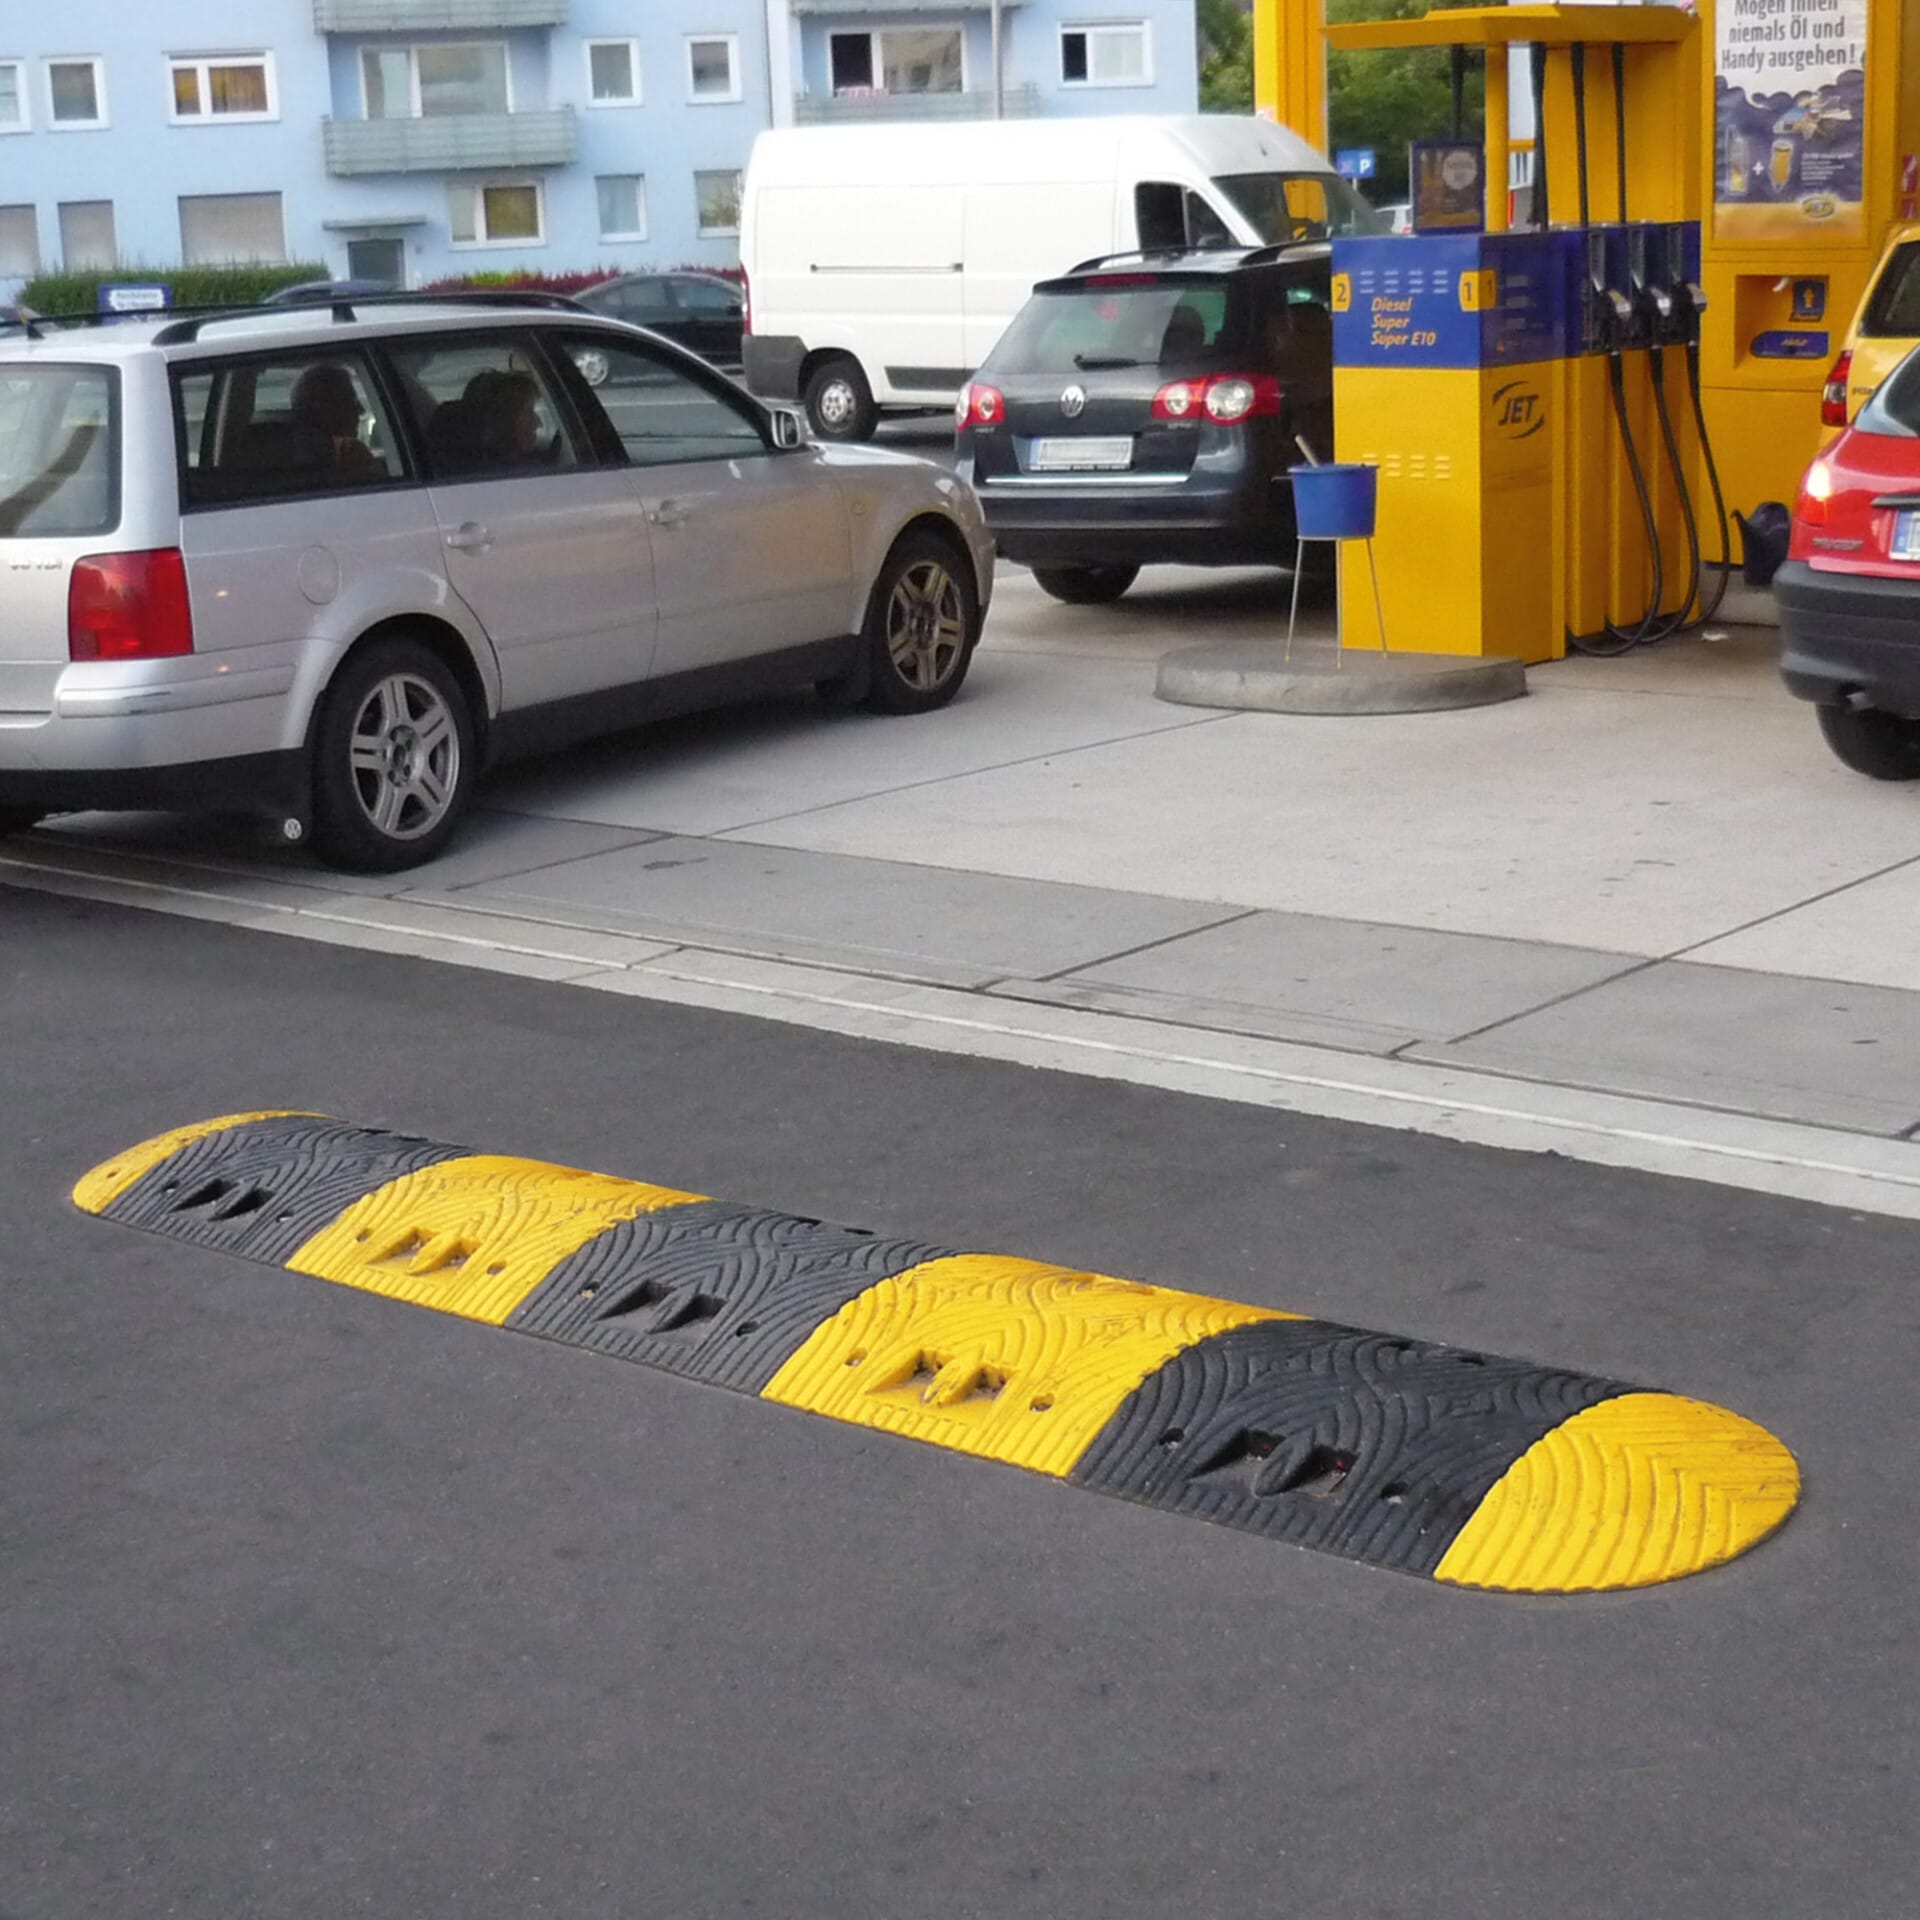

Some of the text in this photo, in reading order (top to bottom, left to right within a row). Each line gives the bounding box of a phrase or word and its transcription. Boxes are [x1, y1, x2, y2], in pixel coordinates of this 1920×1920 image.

[1729, 14, 1845, 43] niemals Öl und
[1721, 46, 1765, 74] Handy
[1336, 282, 1347, 303] 2
[1463, 281, 1472, 302] 1
[1371, 297, 1413, 312] Diesel
[1371, 314, 1410, 332] Super
[1371, 331, 1437, 349] Super E10
[1498, 393, 1539, 427] JET
